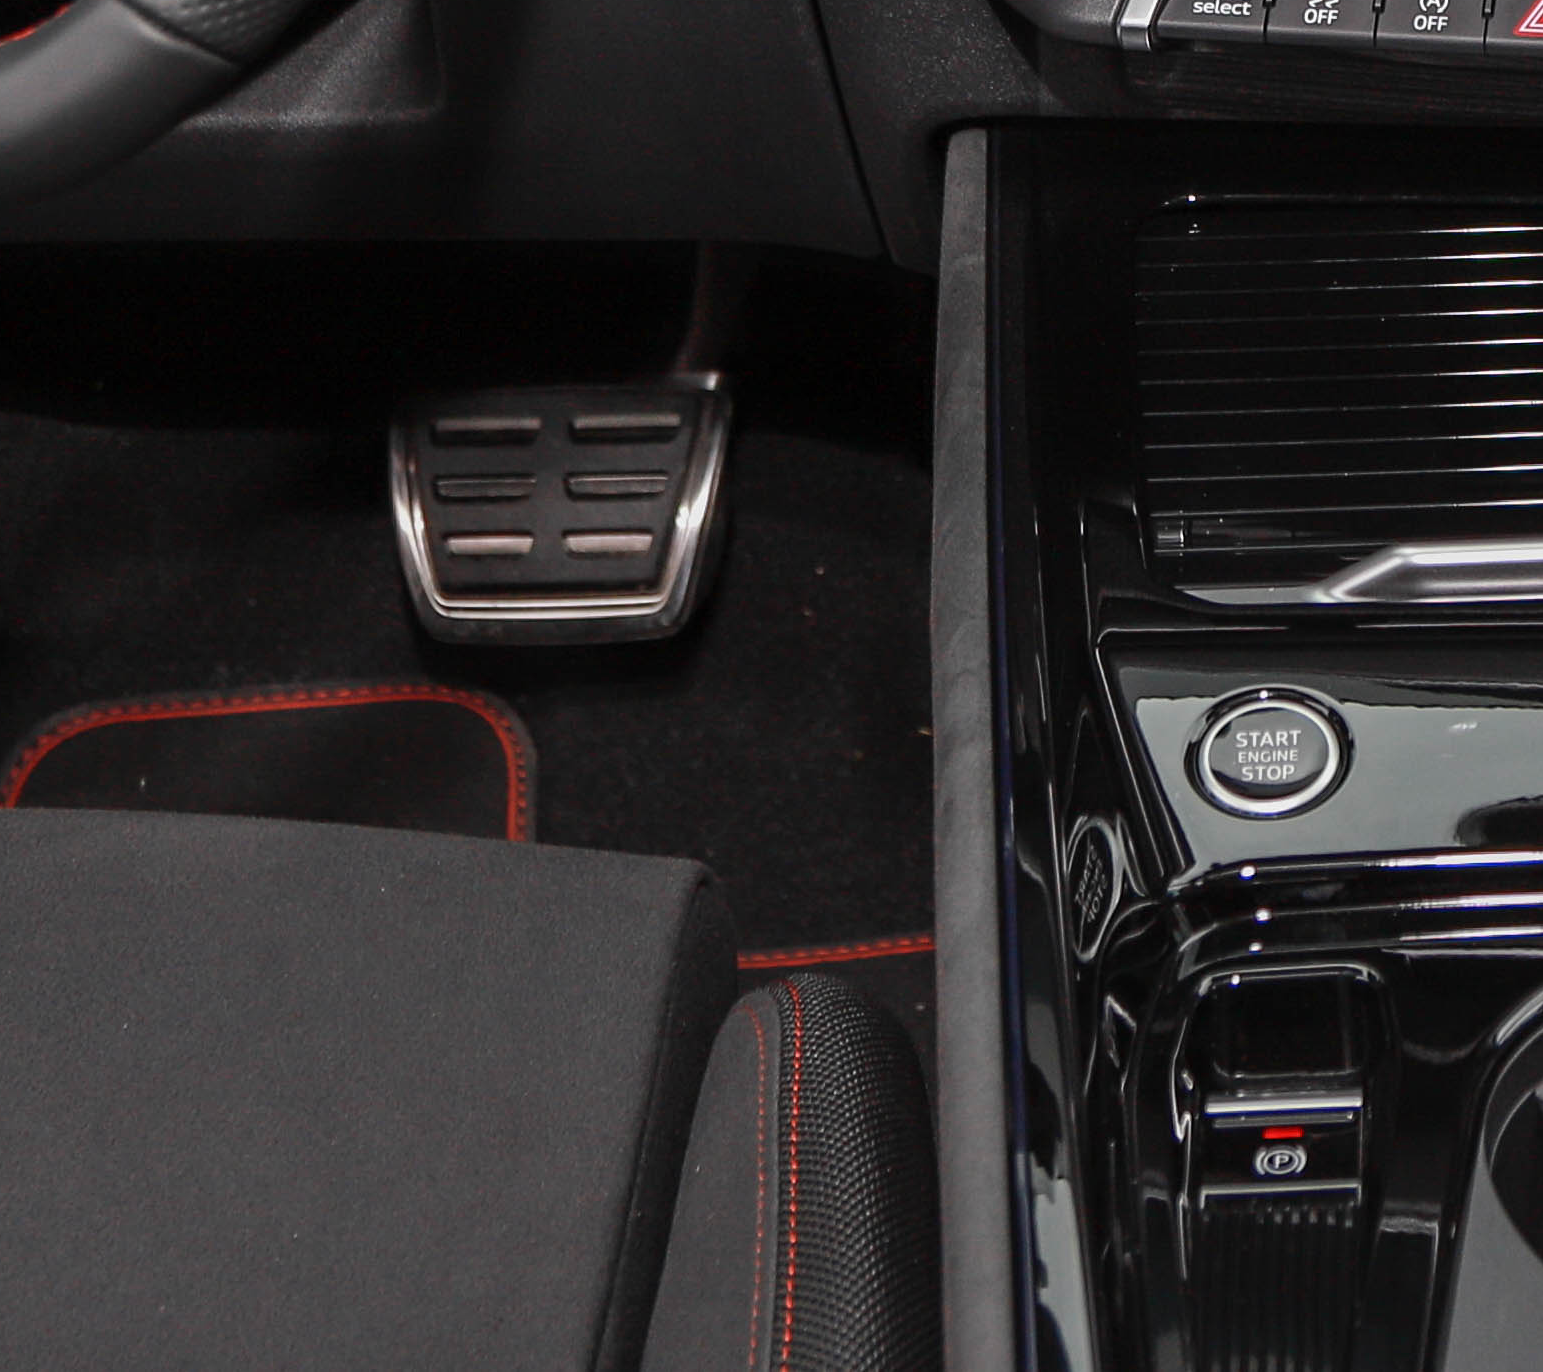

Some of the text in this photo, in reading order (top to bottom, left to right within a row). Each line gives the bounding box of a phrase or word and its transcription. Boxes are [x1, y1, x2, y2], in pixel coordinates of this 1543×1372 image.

[1304, 8, 1339, 25] OFF
[1413, 14, 1449, 32] OFF
[1235, 729, 1302, 749] START
[1237, 749, 1299, 764] ENGINE
[1241, 764, 1295, 781] STOP
